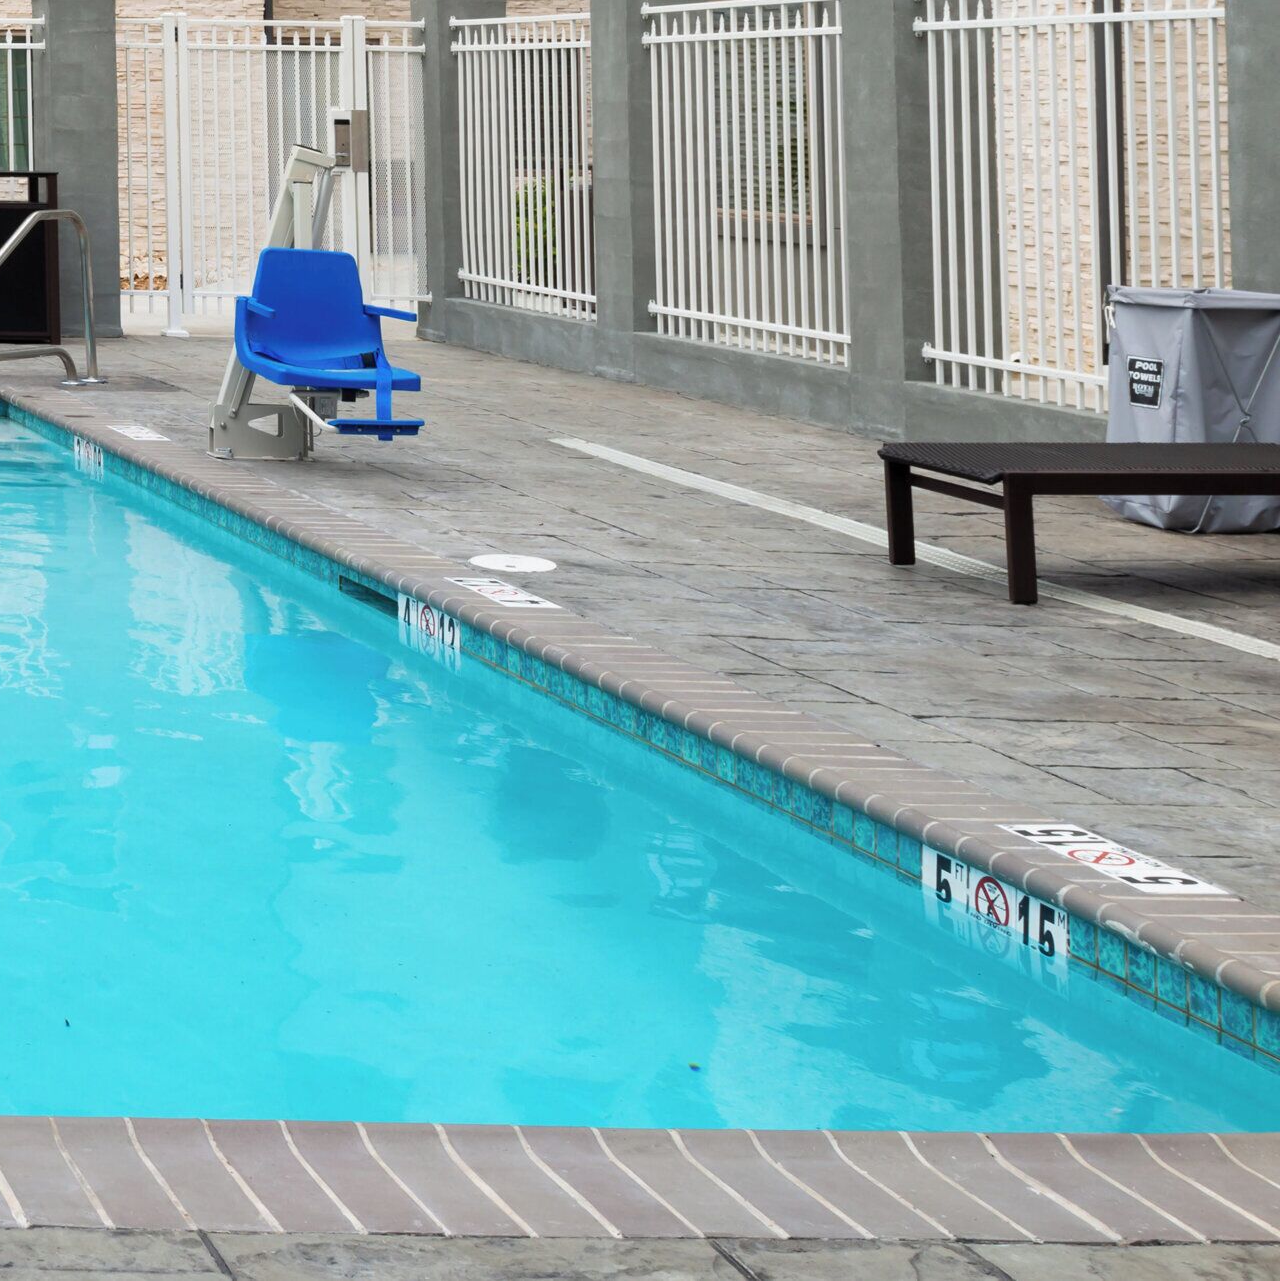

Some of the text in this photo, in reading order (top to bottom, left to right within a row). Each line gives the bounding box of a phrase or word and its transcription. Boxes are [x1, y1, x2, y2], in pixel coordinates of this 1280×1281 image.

[1135, 361, 1158, 371] POOL
[1129, 371, 1161, 383] TOWELS
[936, 853, 964, 904] 5 FT
